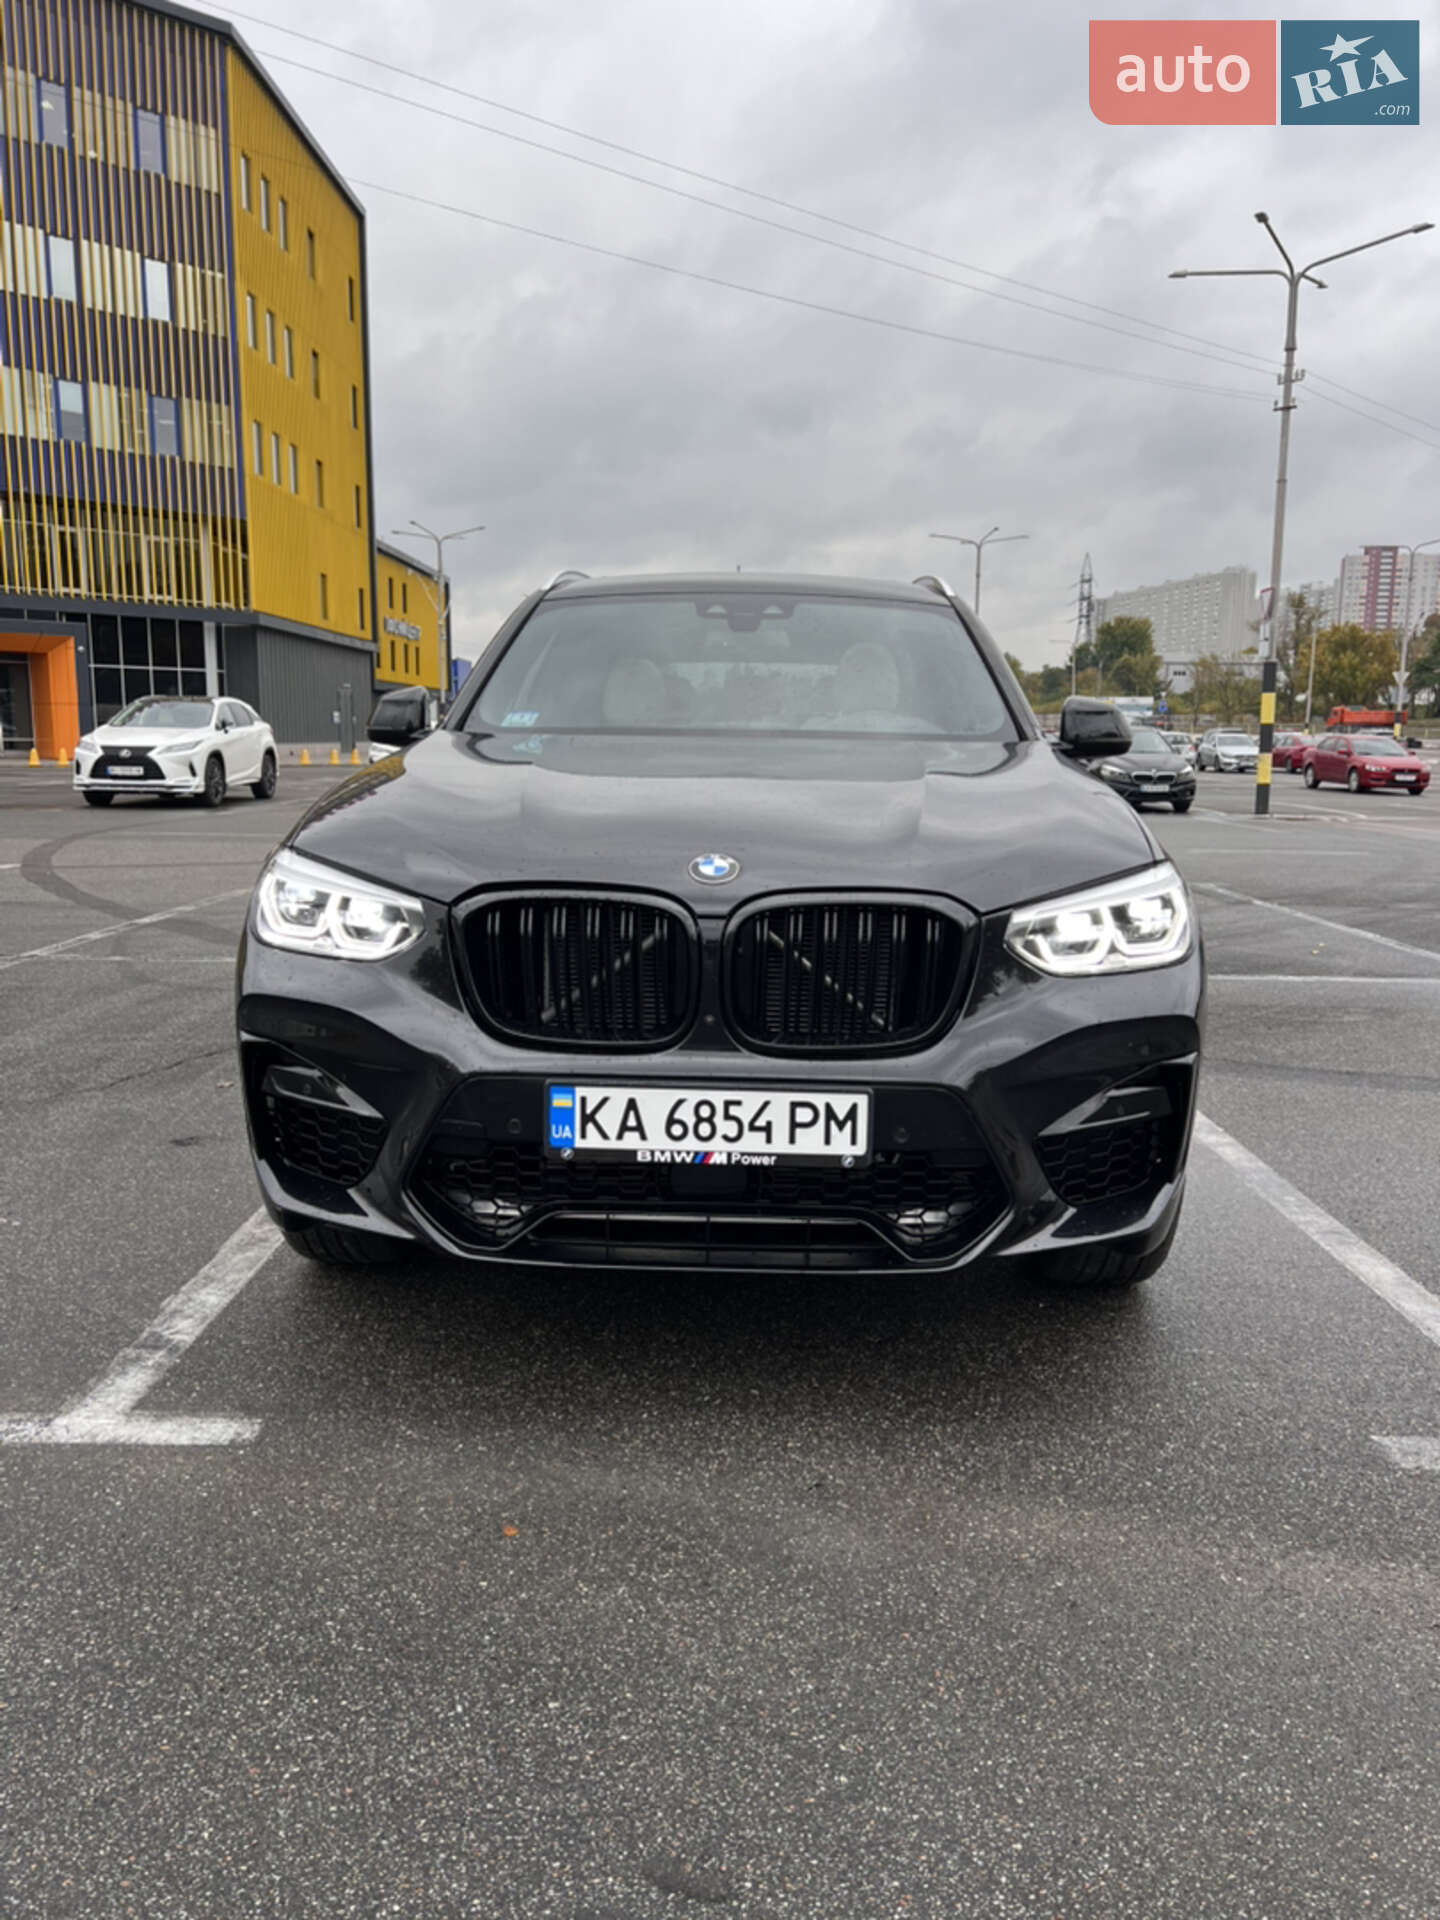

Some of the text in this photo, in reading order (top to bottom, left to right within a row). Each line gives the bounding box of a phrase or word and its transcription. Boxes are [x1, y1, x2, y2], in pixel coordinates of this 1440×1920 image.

[579, 1096, 859, 1147] KA 6854 PM
[551, 1124, 573, 1140] UA
[636, 1150, 694, 1163] BMW
[731, 1151, 777, 1166] Power
